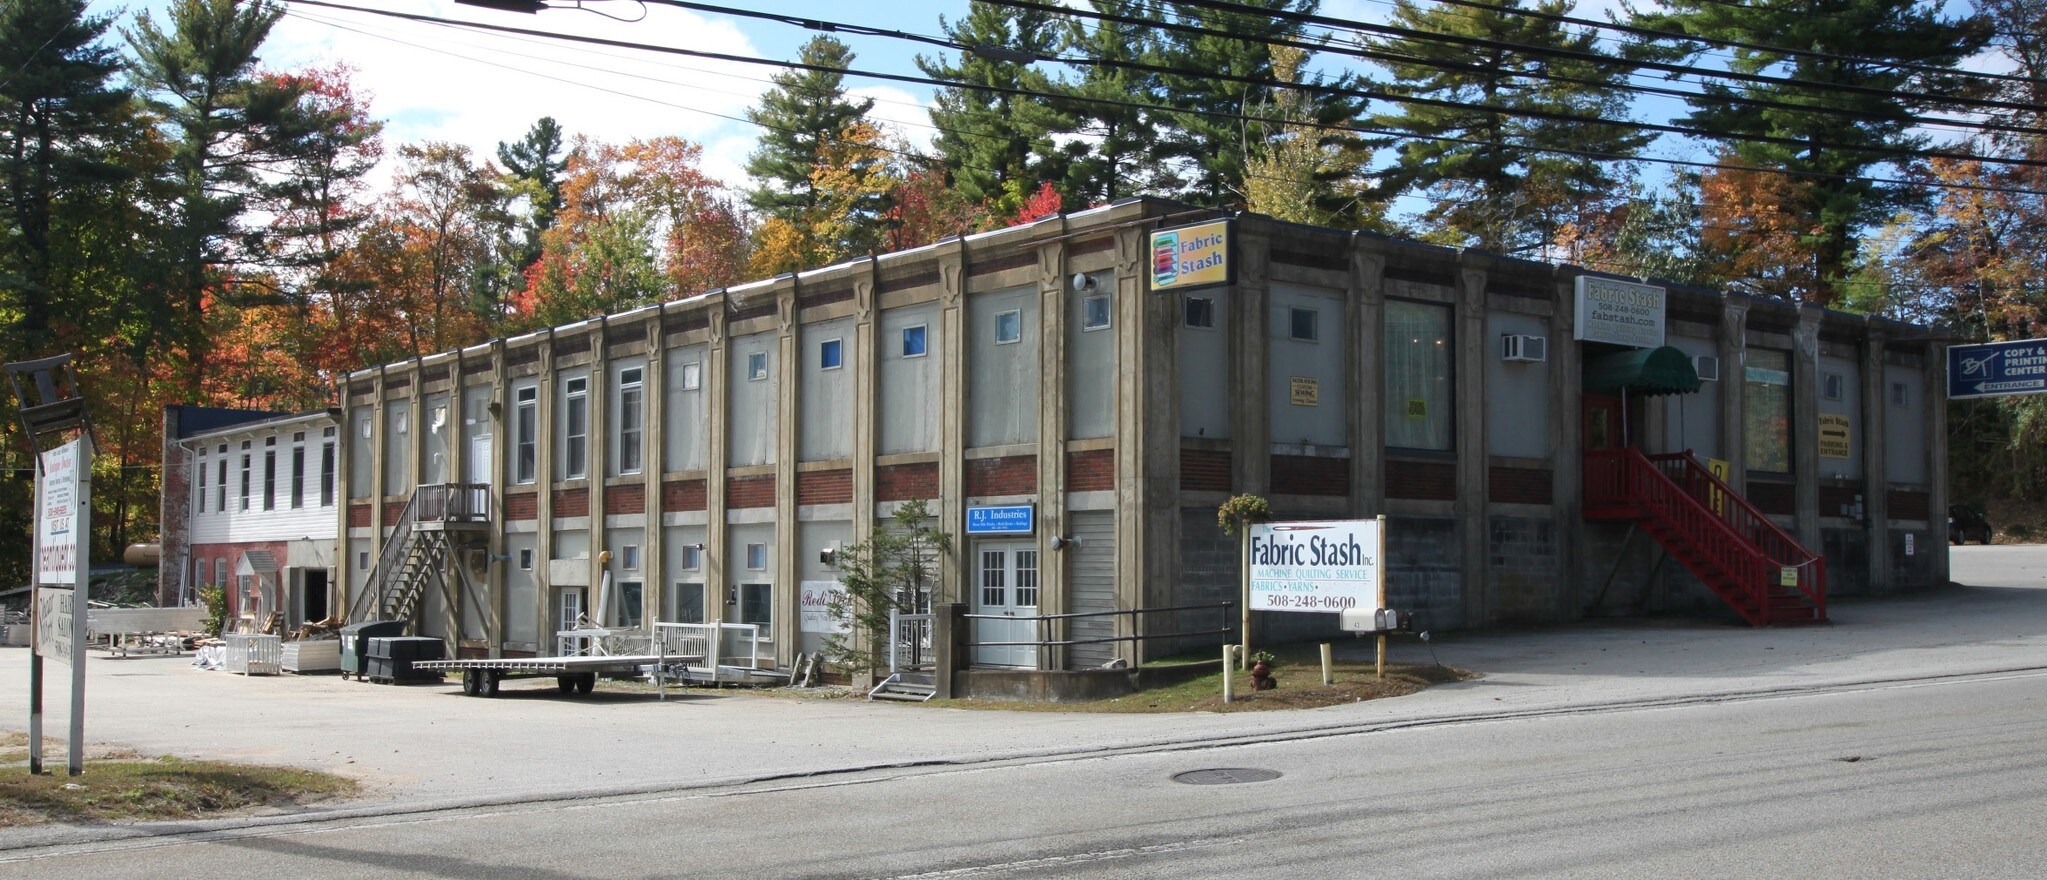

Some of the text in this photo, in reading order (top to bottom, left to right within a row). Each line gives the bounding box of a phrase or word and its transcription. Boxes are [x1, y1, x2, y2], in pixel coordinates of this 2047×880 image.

[1181, 233, 1223, 253] Fabric
[1181, 251, 1223, 274] Stash
[1587, 282, 1660, 309] Fabric Stash
[1599, 303, 1649, 316] 508-248-0600
[1592, 311, 1655, 327] fabstash.com
[2004, 347, 2045, 358] COPY &
[2004, 366, 2045, 376] CENTER
[1984, 380, 2040, 390] ENTRANCE
[1820, 440, 1843, 449] PARKING
[1820, 448, 1848, 457] ENTRANCE
[974, 509, 1027, 522] R.J. Industries
[1252, 533, 1374, 567] Fabric Stash Inc.
[1257, 568, 1368, 581] MACHINE QUILTING SERVICE
[1252, 581, 1314, 593] FABRICS YARNS
[802, 589, 826, 607] Redi
[1267, 594, 1356, 609] 508-248-0600
